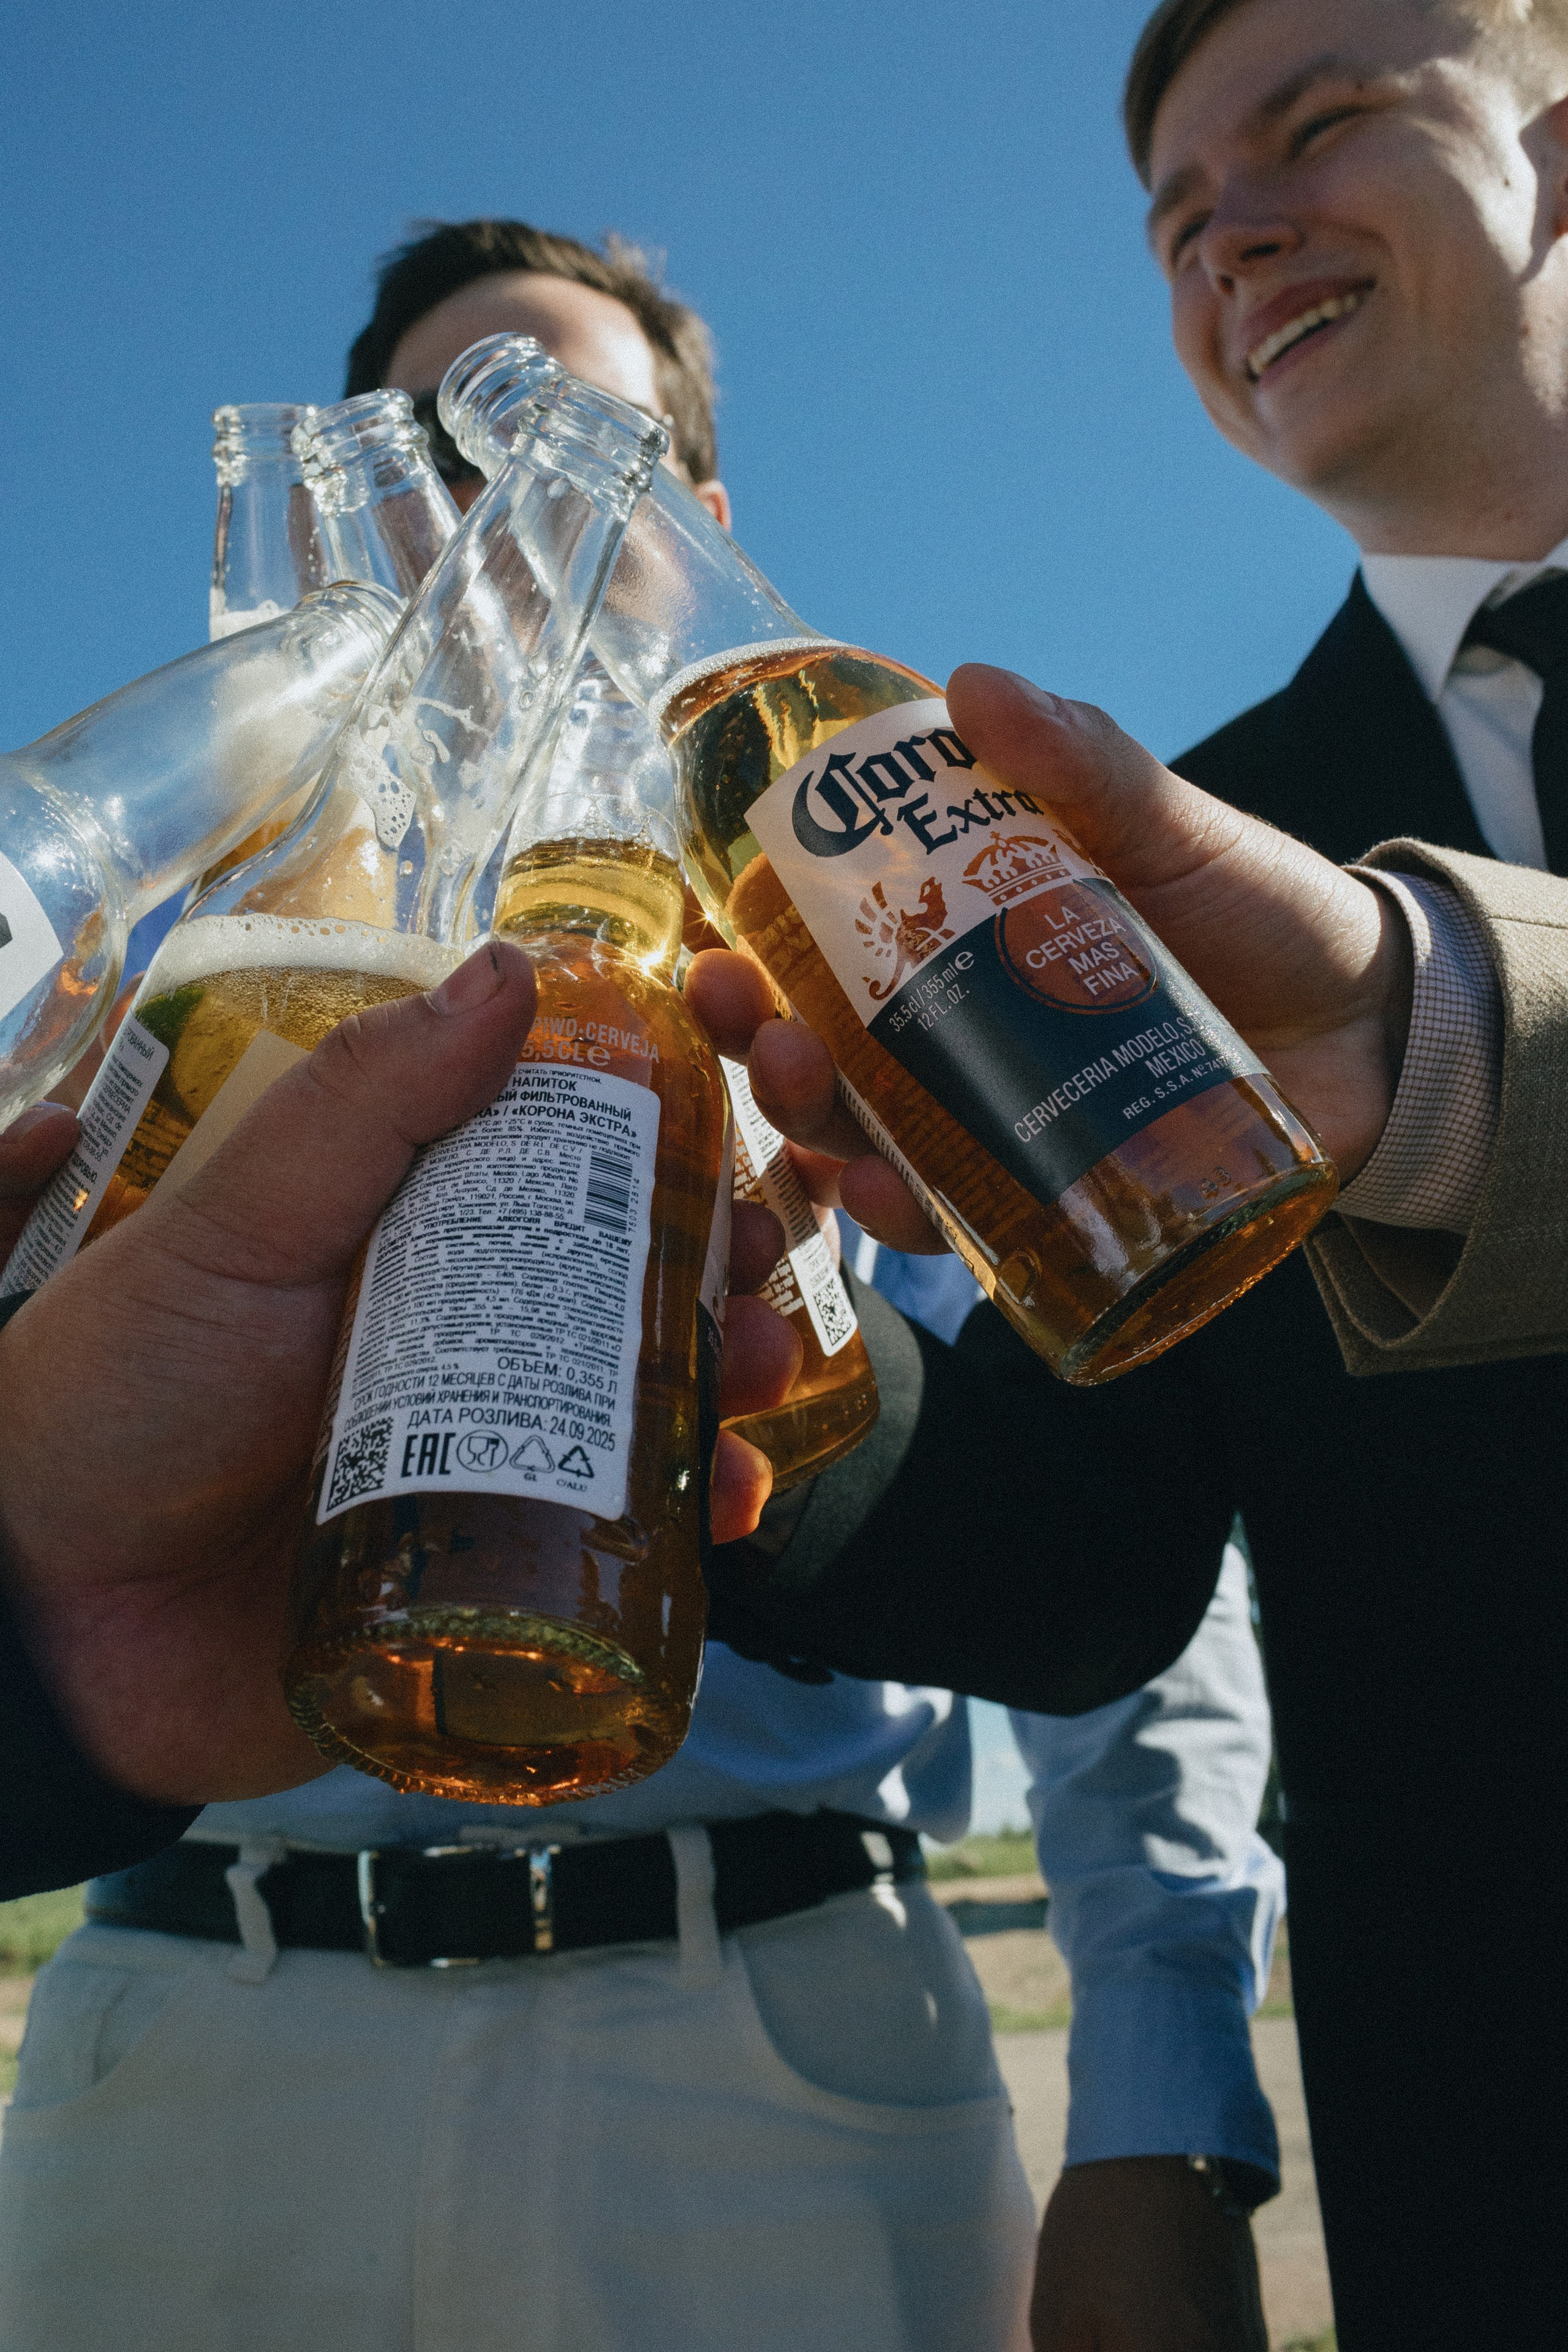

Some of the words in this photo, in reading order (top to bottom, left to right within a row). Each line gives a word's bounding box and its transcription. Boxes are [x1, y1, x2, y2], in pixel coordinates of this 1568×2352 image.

[793, 729, 977, 857] Coro
[897, 788, 1044, 854] Extra
[1044, 907, 1080, 930] LA
[1026, 918, 1126, 968] CERVEZA
[1068, 942, 1119, 974] MAS
[1083, 963, 1139, 995] FINA
[521, 1039, 584, 1062] 5,5CL
[1145, 1039, 1205, 1078] MEXICO
[513, 1077, 577, 1091] НАПИТОК
[1014, 1057, 1118, 1142] CERVECERIA
[1112, 1022, 1186, 1067] MODELO,
[521, 1091, 631, 1121] ФИЛЬТРОВАННЫЙ
[1123, 1096, 1155, 1119] REG.
[512, 1106, 575, 1120] «КОРОНА
[579, 1113, 637, 1138] ЭКСТРА»
[458, 1135, 489, 1144] вскрытия
[553, 1137, 587, 1147] хранению
[530, 1126, 562, 1136] Избегать
[614, 1144, 641, 1157] прямого
[558, 1122, 584, 1131] темных
[586, 1127, 627, 1145] помещениях
[630, 1141, 641, 1150] при
[429, 1142, 472, 1158] CERVECERIA
[559, 1152, 581, 1161] Место
[427, 1166, 470, 1180] деятельности
[444, 1156, 490, 1168] юридического
[541, 1172, 565, 1181] Alberto
[423, 1216, 482, 1231] УПОТРЕБЛЕНИЕ
[554, 1220, 586, 1232] ВРЕДИТ
[598, 1231, 632, 1246] ВАШЕМУ
[443, 1225, 504, 1234] противопоказан
[544, 1228, 589, 1242] подросткам
[567, 1249, 593, 1259] других
[600, 1257, 629, 1271] органов
[573, 1241, 630, 1262] заболеваниями
[499, 1256, 555, 1267] зернопродукты
[559, 1262, 582, 1272] (крупа
[608, 1268, 628, 1281] солод
[522, 1272, 558, 1284] Содержит
[595, 1287, 625, 1303] Пищевая
[573, 1291, 606, 1305] углеводы
[513, 1297, 560, 1309] Содержание
[562, 1305, 598, 1319] этилового
[600, 1314, 624, 1327] спирта
[581, 1300, 624, 1319] Содержание
[537, 1317, 569, 1328] вредных
[565, 1313, 624, 1334] Экстрактивность
[496, 1322, 552, 1333] установленные
[578, 1334, 609, 1348] 021/2011
[530, 1333, 564, 1344] 029/2012
[475, 1338, 537, 1348] ароматизаторов
[561, 1347, 619, 1370] технологических
[493, 1347, 542, 1357] требованиям
[559, 1354, 569, 1363] ТС
[497, 1356, 562, 1378] ОБЪЕМ:
[567, 1366, 604, 1389] 0,355
[608, 1380, 618, 1395] Л
[374, 1376, 424, 1398] ГОДНОСТИ
[429, 1374, 439, 1386] 12
[441, 1373, 495, 1387] МЕСЯЦЕВ
[498, 1374, 506, 1386] С
[507, 1375, 540, 1390] ДАТЫ
[543, 1378, 591, 1403] РОЗЛИВА
[594, 1390, 616, 1410] ПРИ
[394, 1389, 435, 1409] УСЛОВИЙ
[437, 1390, 490, 1403] ХРАНЕНИЯ
[492, 1390, 499, 1403] И
[503, 1391, 611, 1428] ТРАНСПОРТИРОВАНИЯ.
[407, 1409, 453, 1430] ДАТА
[459, 1408, 547, 1431] РОЗЛИВА:
[549, 1416, 616, 1452] 24.09.2025
